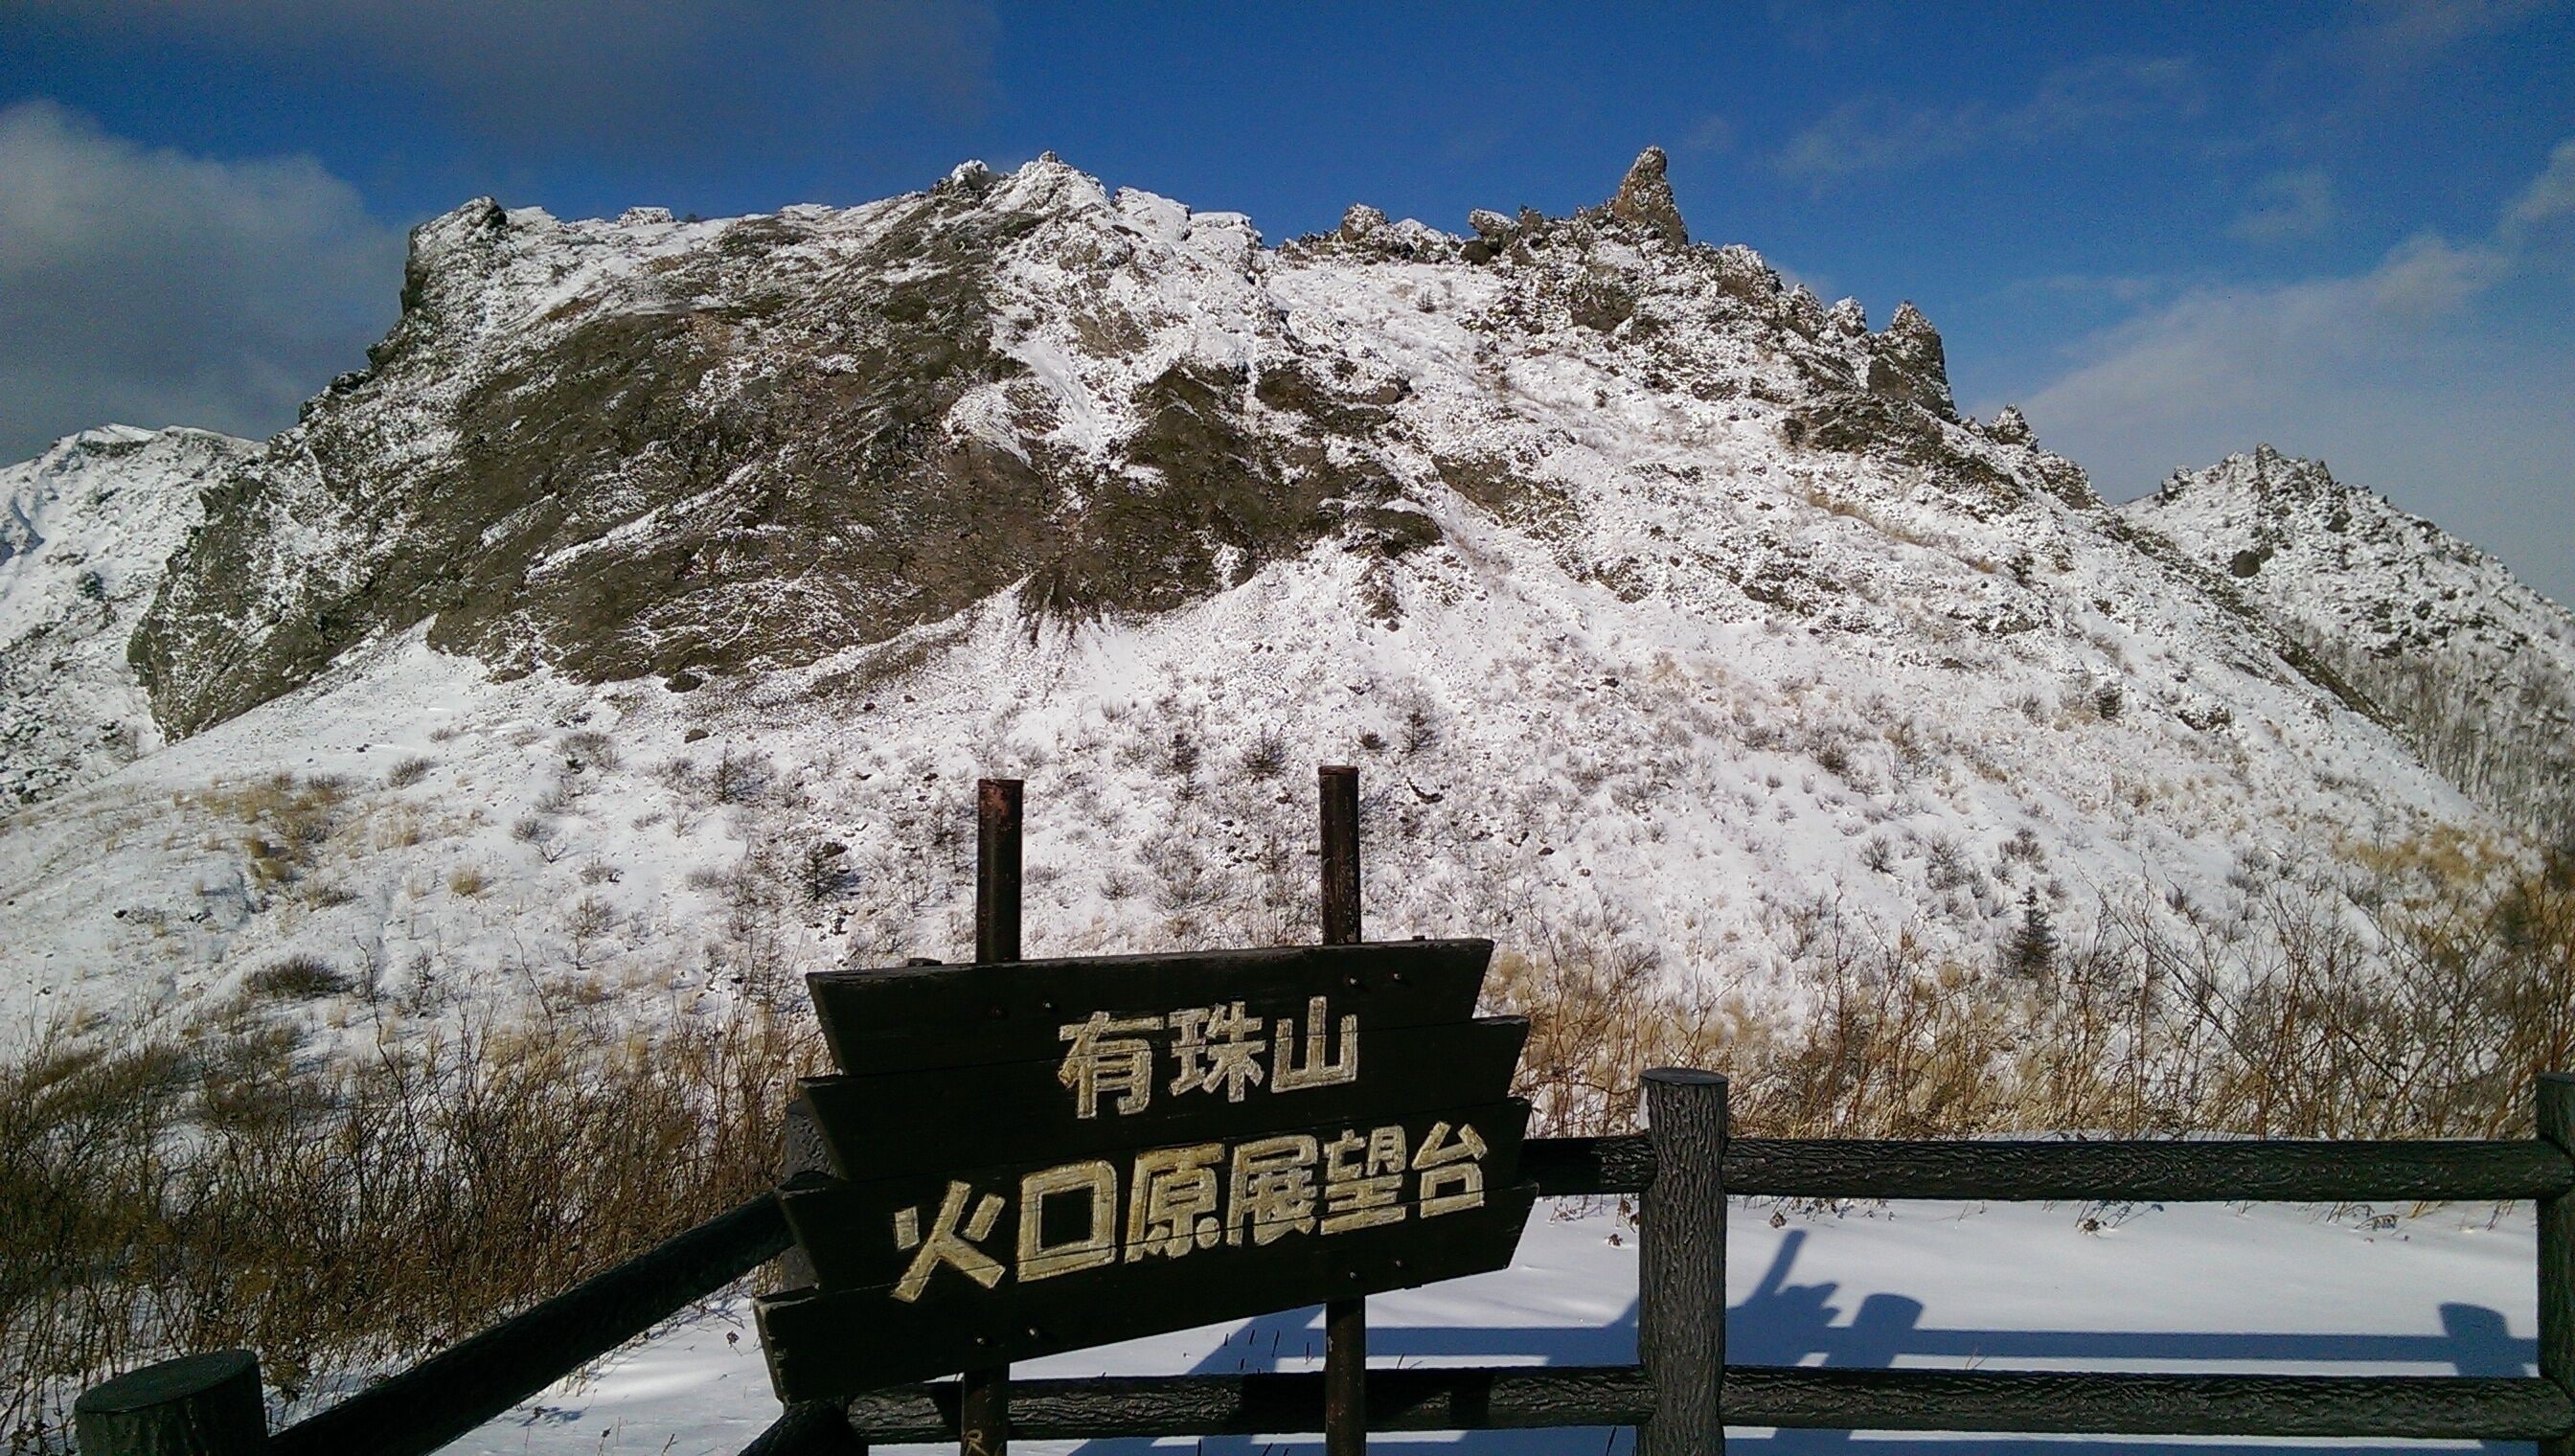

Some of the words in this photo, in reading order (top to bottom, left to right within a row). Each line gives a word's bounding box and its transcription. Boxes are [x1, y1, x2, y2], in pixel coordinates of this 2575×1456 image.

[1058, 995, 1357, 1119] 有珠山
[891, 1121, 1488, 1302] 火口原展望台
